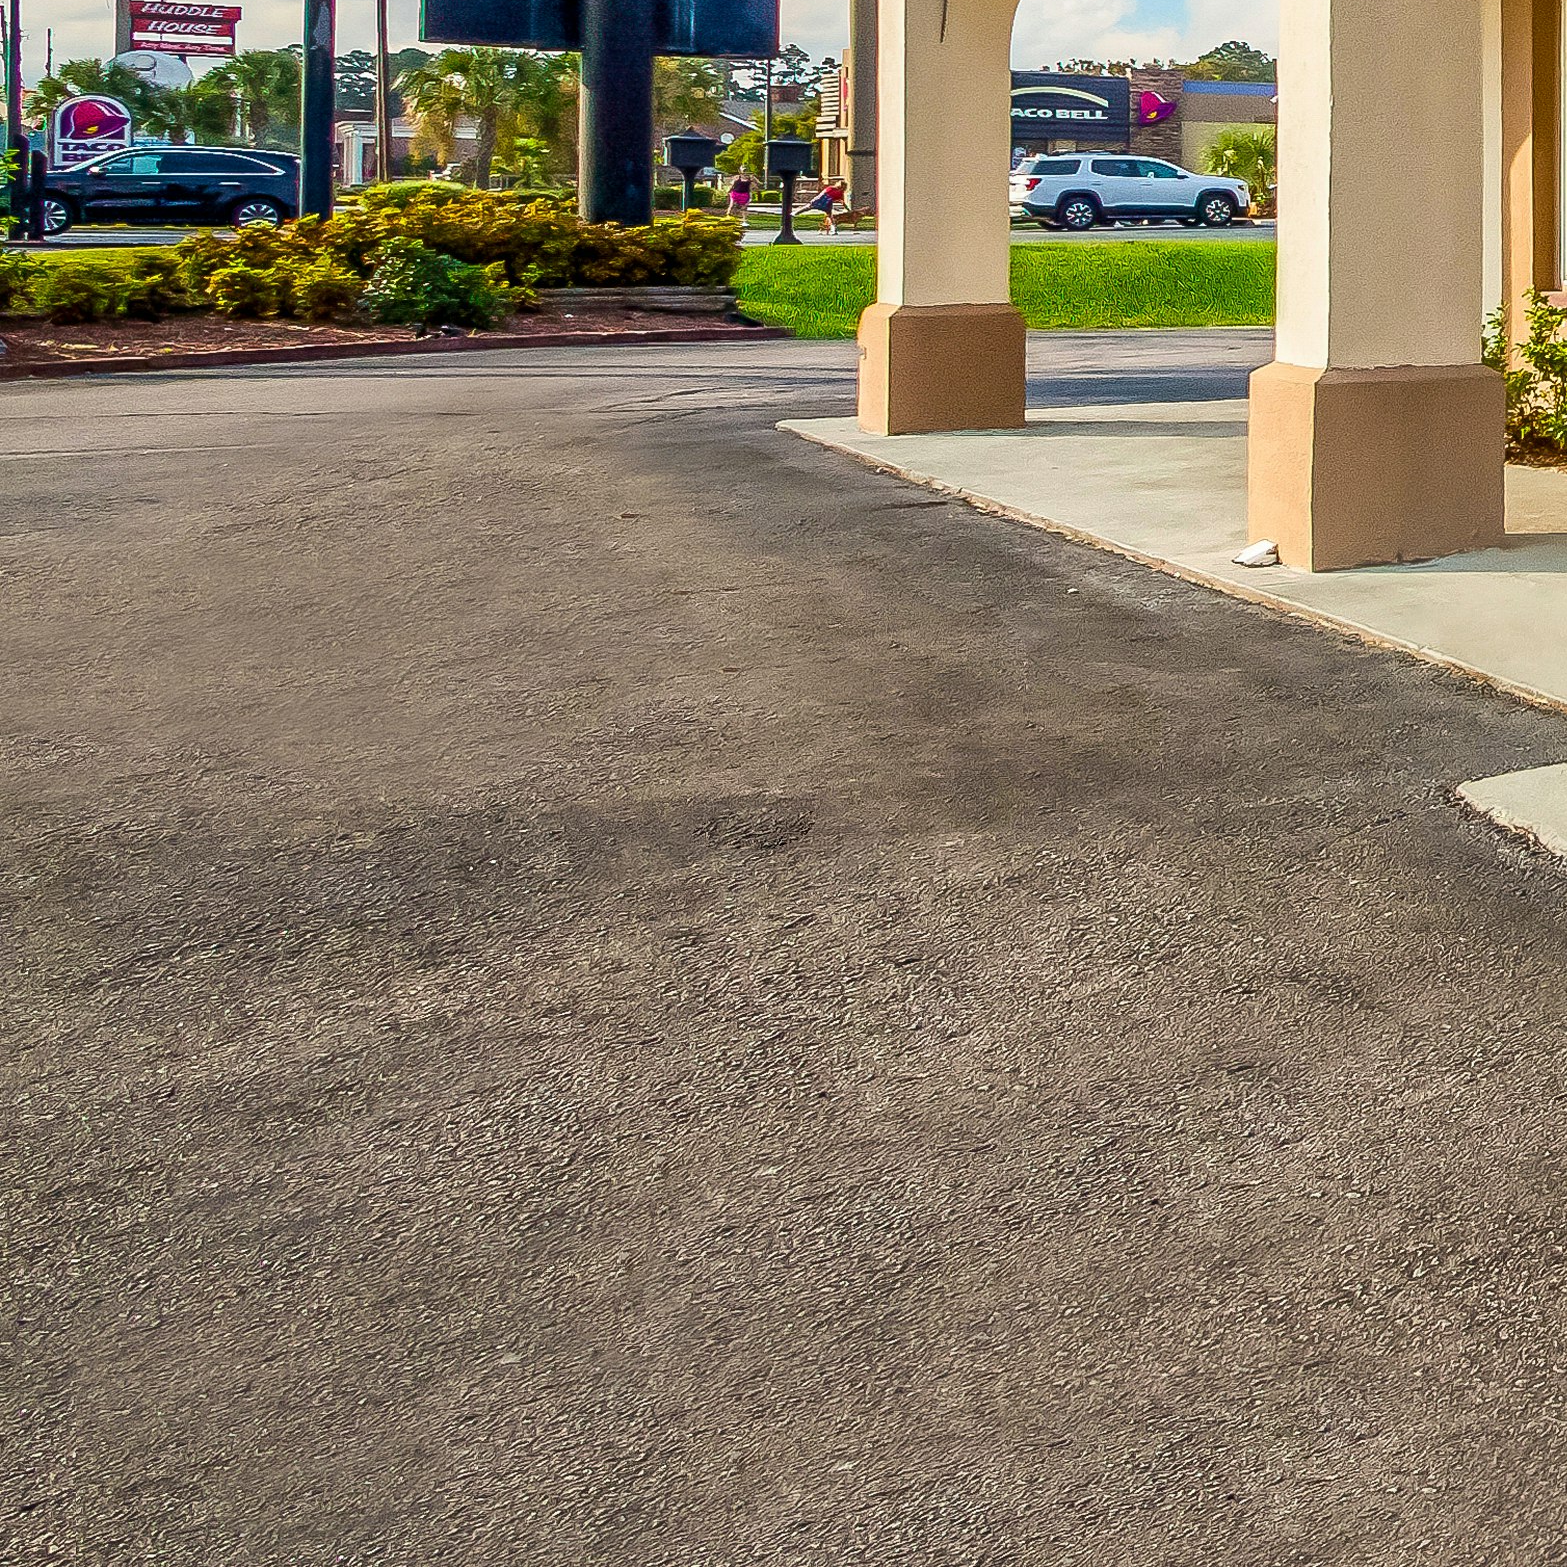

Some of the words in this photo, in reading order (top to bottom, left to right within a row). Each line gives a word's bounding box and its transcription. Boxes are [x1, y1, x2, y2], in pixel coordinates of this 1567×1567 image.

[141, 2, 228, 18] HUDDLE
[147, 20, 222, 35] HOUSE
[1010, 108, 1053, 118] ACO
[1056, 109, 1108, 120] BELL
[58, 142, 127, 152] TACO
